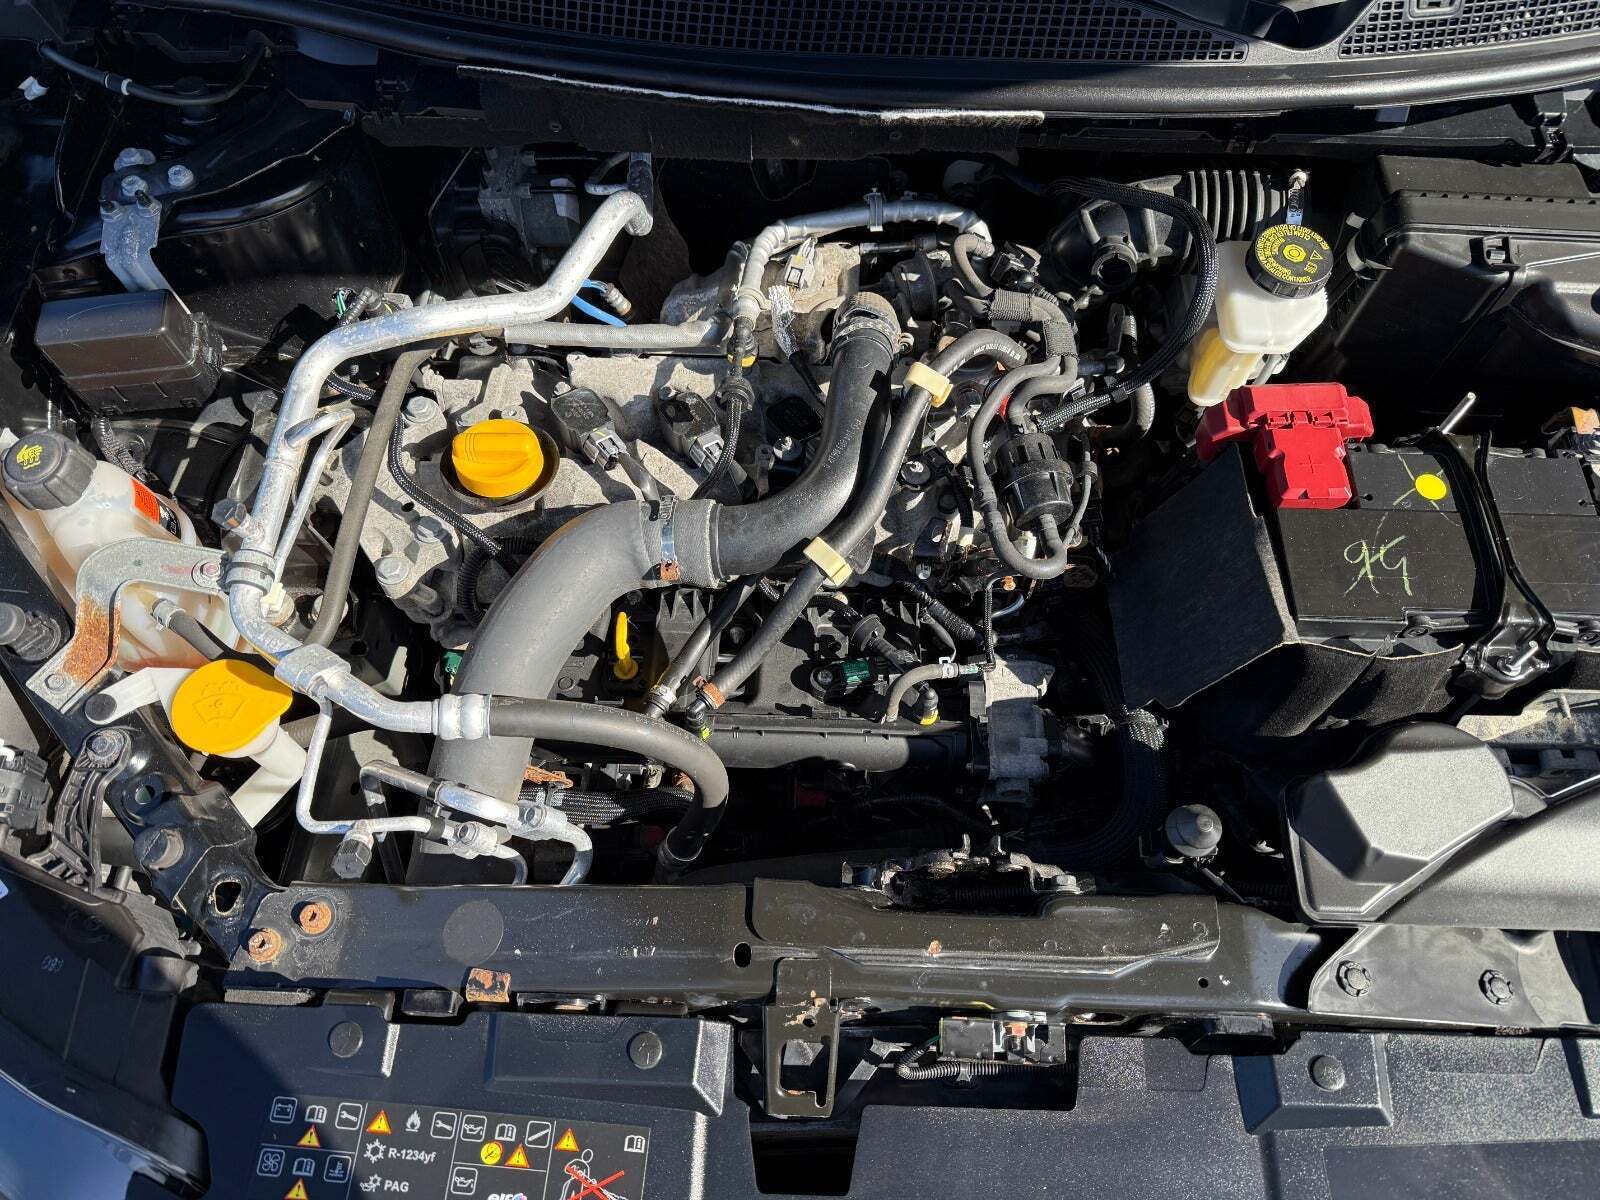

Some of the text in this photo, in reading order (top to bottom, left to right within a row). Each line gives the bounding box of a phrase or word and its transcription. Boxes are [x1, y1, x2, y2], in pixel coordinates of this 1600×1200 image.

[1294, 230, 1311, 241] CLEAN
[388, 1148, 436, 1164] R-1234yf
[384, 1179, 409, 1193] PAG
